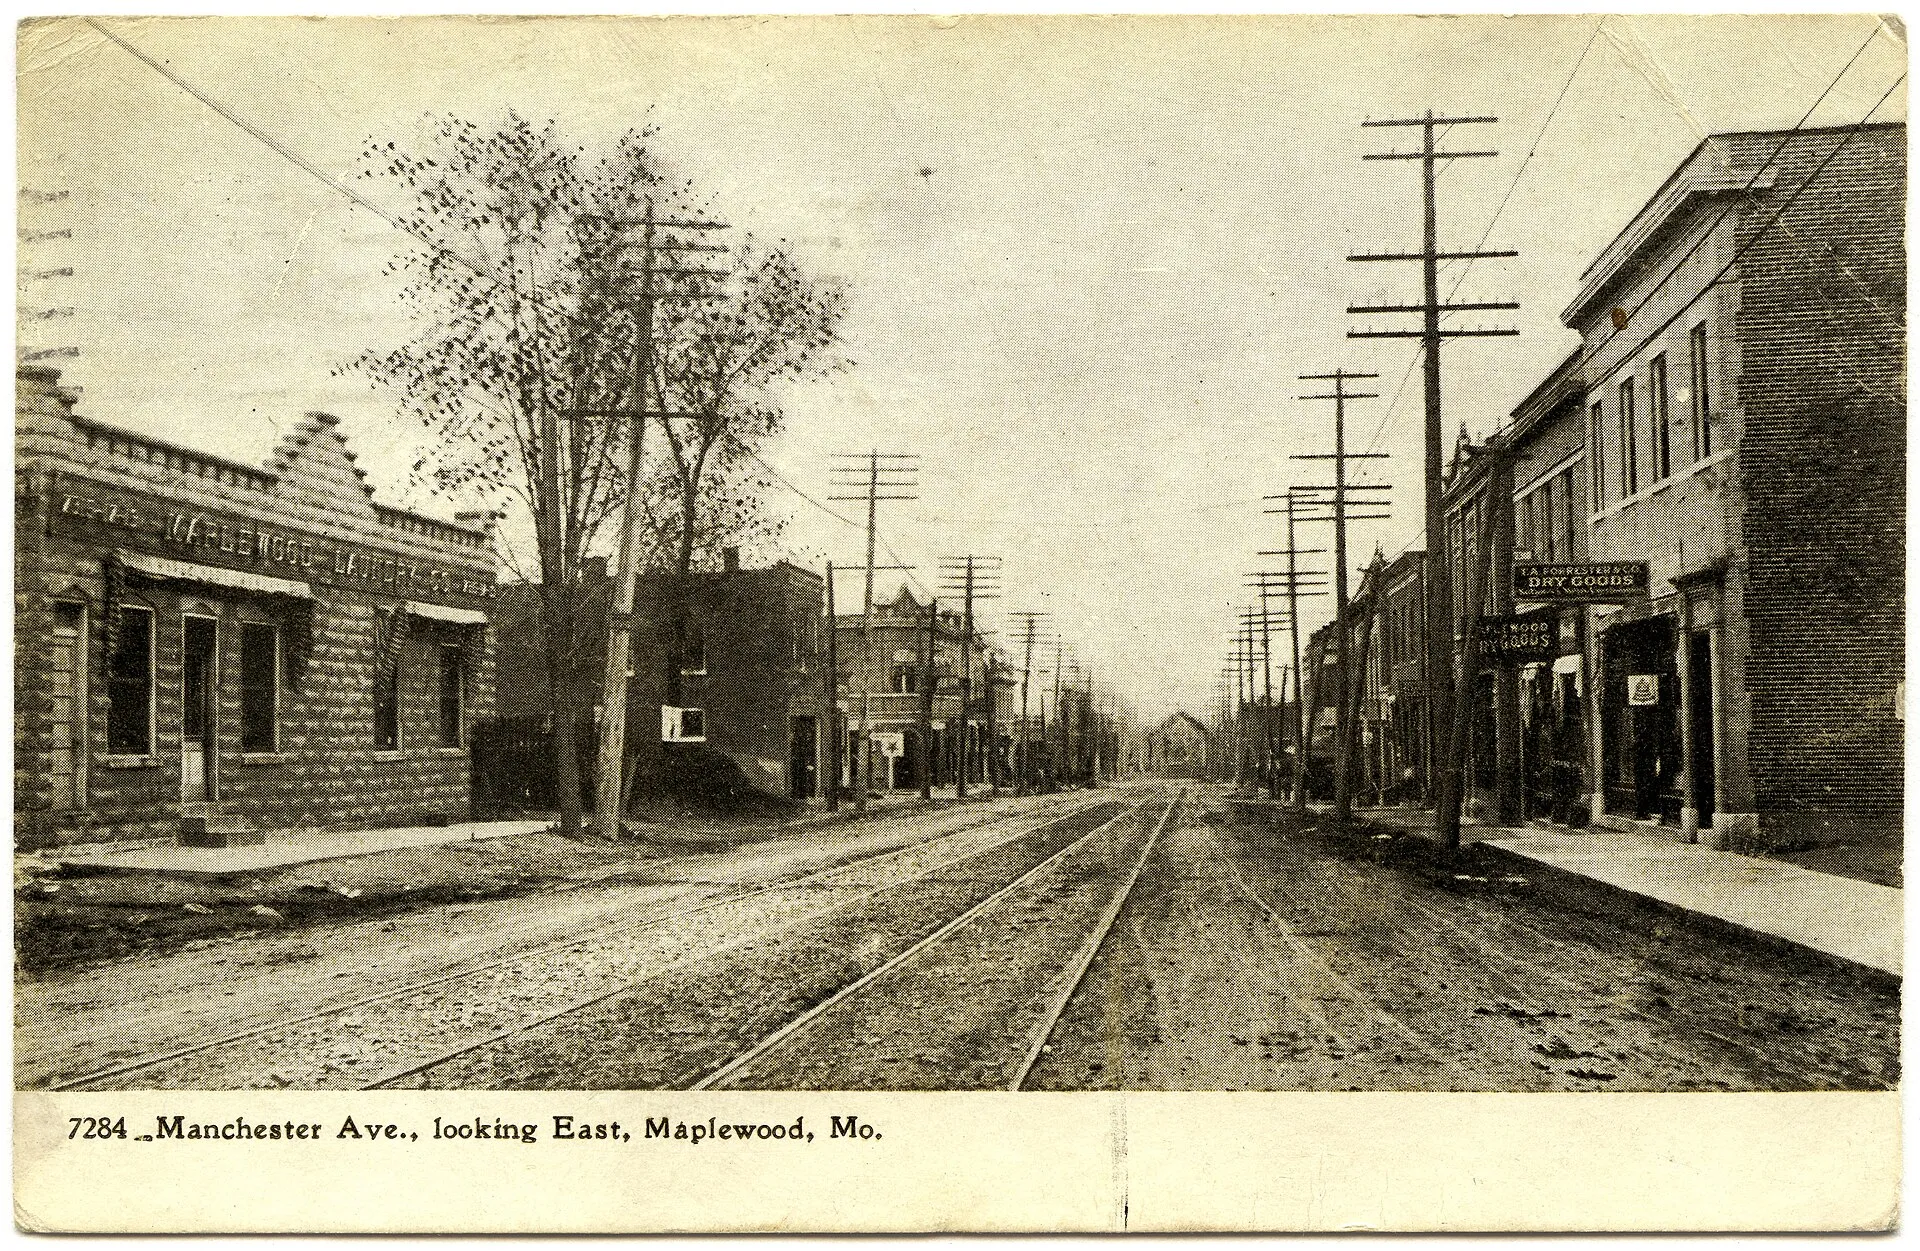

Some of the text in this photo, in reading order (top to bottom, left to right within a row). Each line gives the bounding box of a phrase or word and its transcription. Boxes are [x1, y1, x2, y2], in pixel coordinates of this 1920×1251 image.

[164, 512, 313, 567] MAPLEWOOD
[1528, 575, 1634, 588] DRY GOODS
[1500, 632, 1550, 651] GOODS
